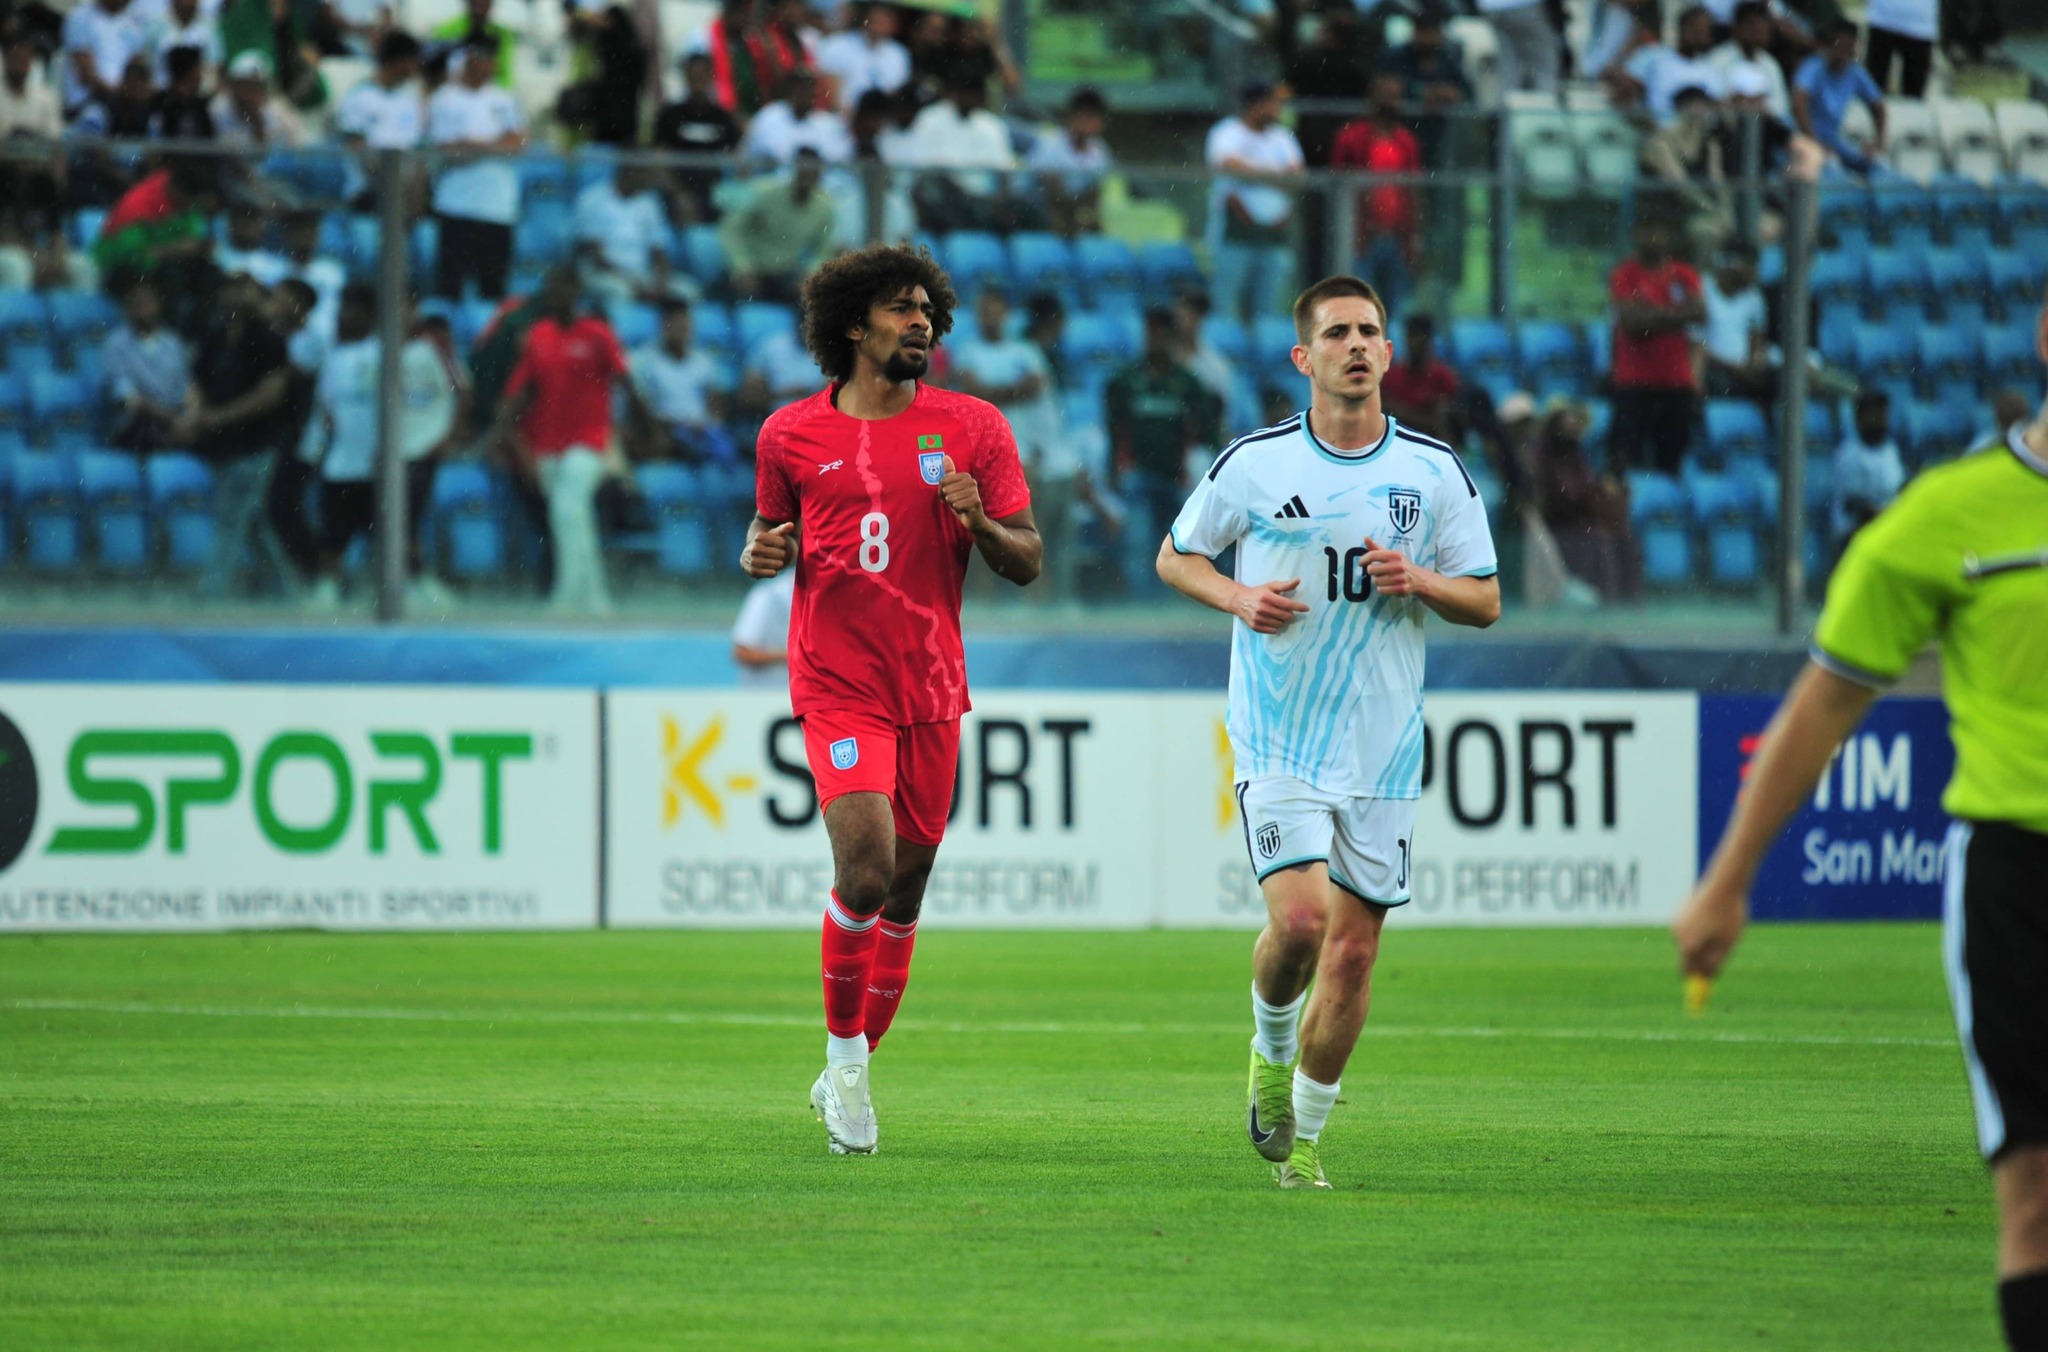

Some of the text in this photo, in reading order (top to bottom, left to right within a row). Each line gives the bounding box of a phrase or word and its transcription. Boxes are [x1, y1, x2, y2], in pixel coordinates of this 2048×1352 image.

[859, 512, 890, 573] 8
[1324, 546, 1372, 602] 10
[43, 730, 534, 855] SPORT
[661, 714, 1090, 828] K-SRT
[1803, 827, 1946, 885] San Mar
[0, 886, 203, 921] UTENZIONE
[928, 858, 1099, 914] ERFORM
[1454, 858, 1640, 913] PERFORM
